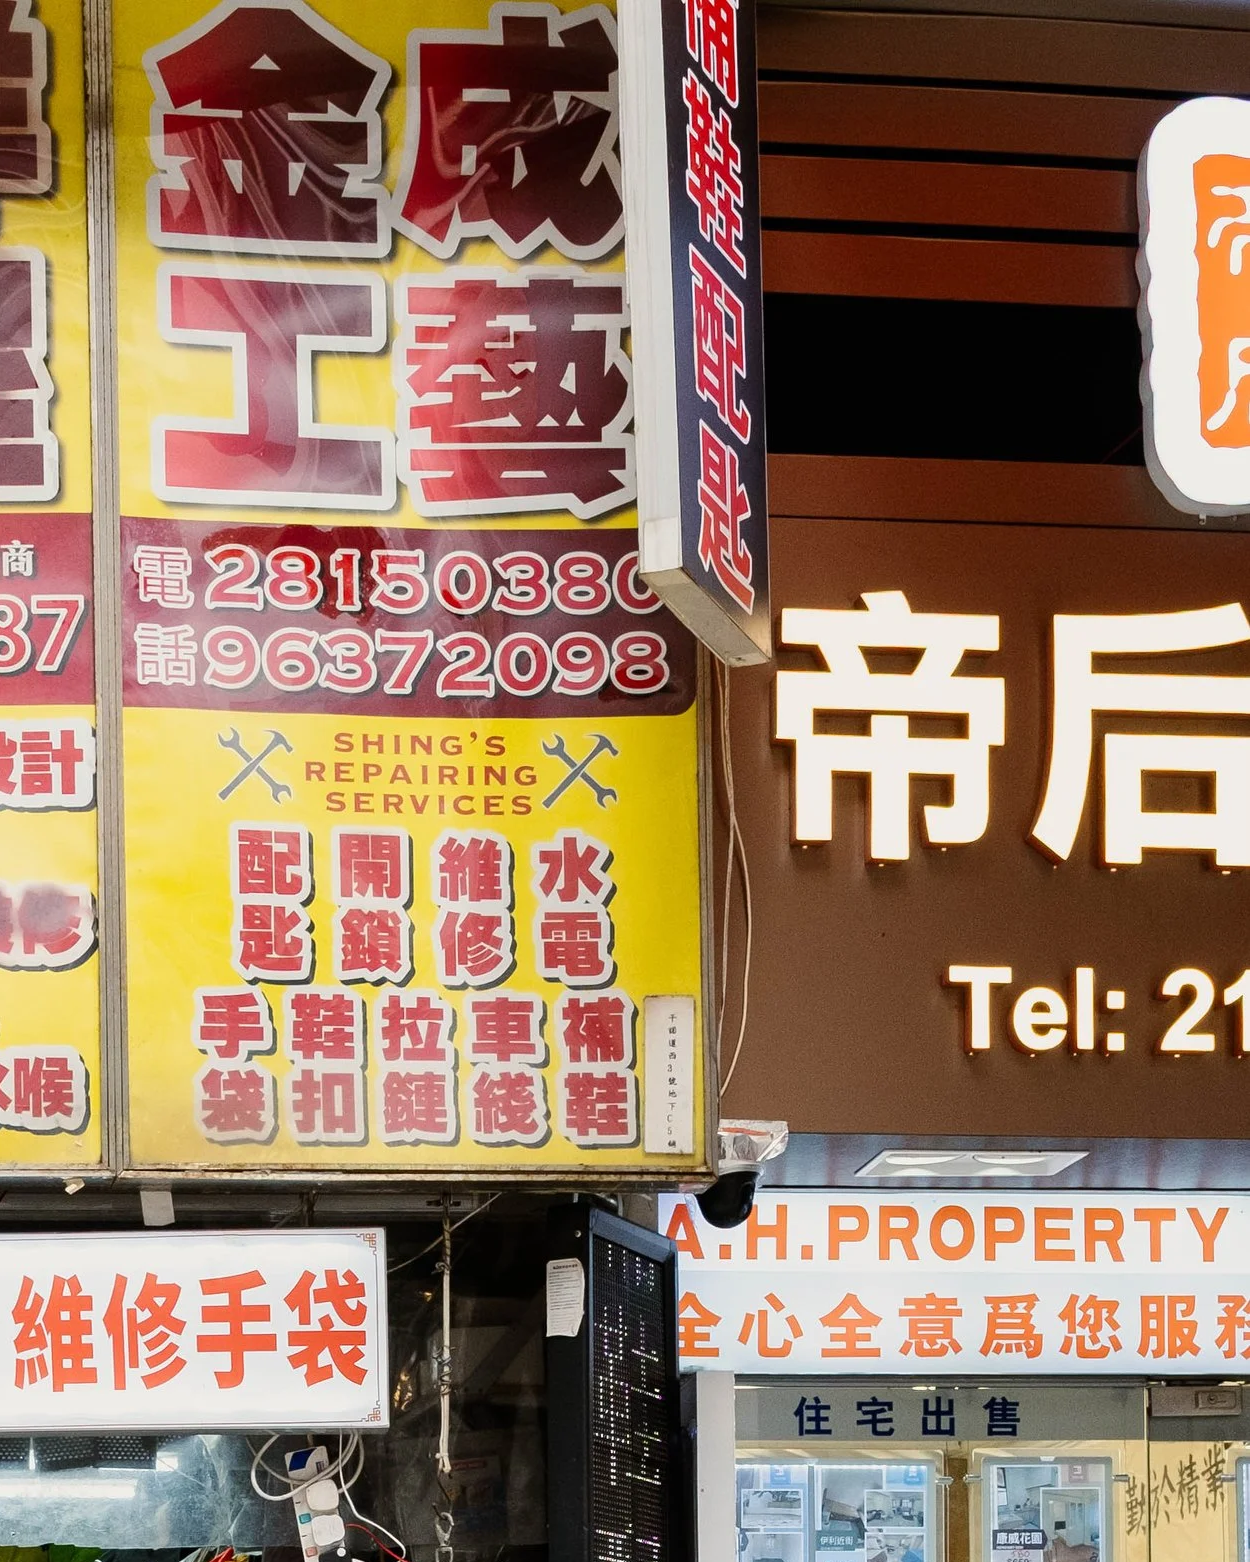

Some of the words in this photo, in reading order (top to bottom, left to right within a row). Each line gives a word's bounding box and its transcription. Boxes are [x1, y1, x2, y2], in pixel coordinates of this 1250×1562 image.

[162, 276, 630, 506] 工藝
[204, 543, 662, 616] 28150380
[202, 625, 670, 699] 96372098
[333, 731, 507, 757] SHING'S
[776, 590, 1250, 867] 帝后
[304, 761, 539, 788] REPAIRING
[324, 792, 534, 817] SERVICES
[948, 965, 1127, 1053] Tel:
[11, 1268, 368, 1392] 維修手袋
[793, 1395, 1023, 1437] 住宅出售
